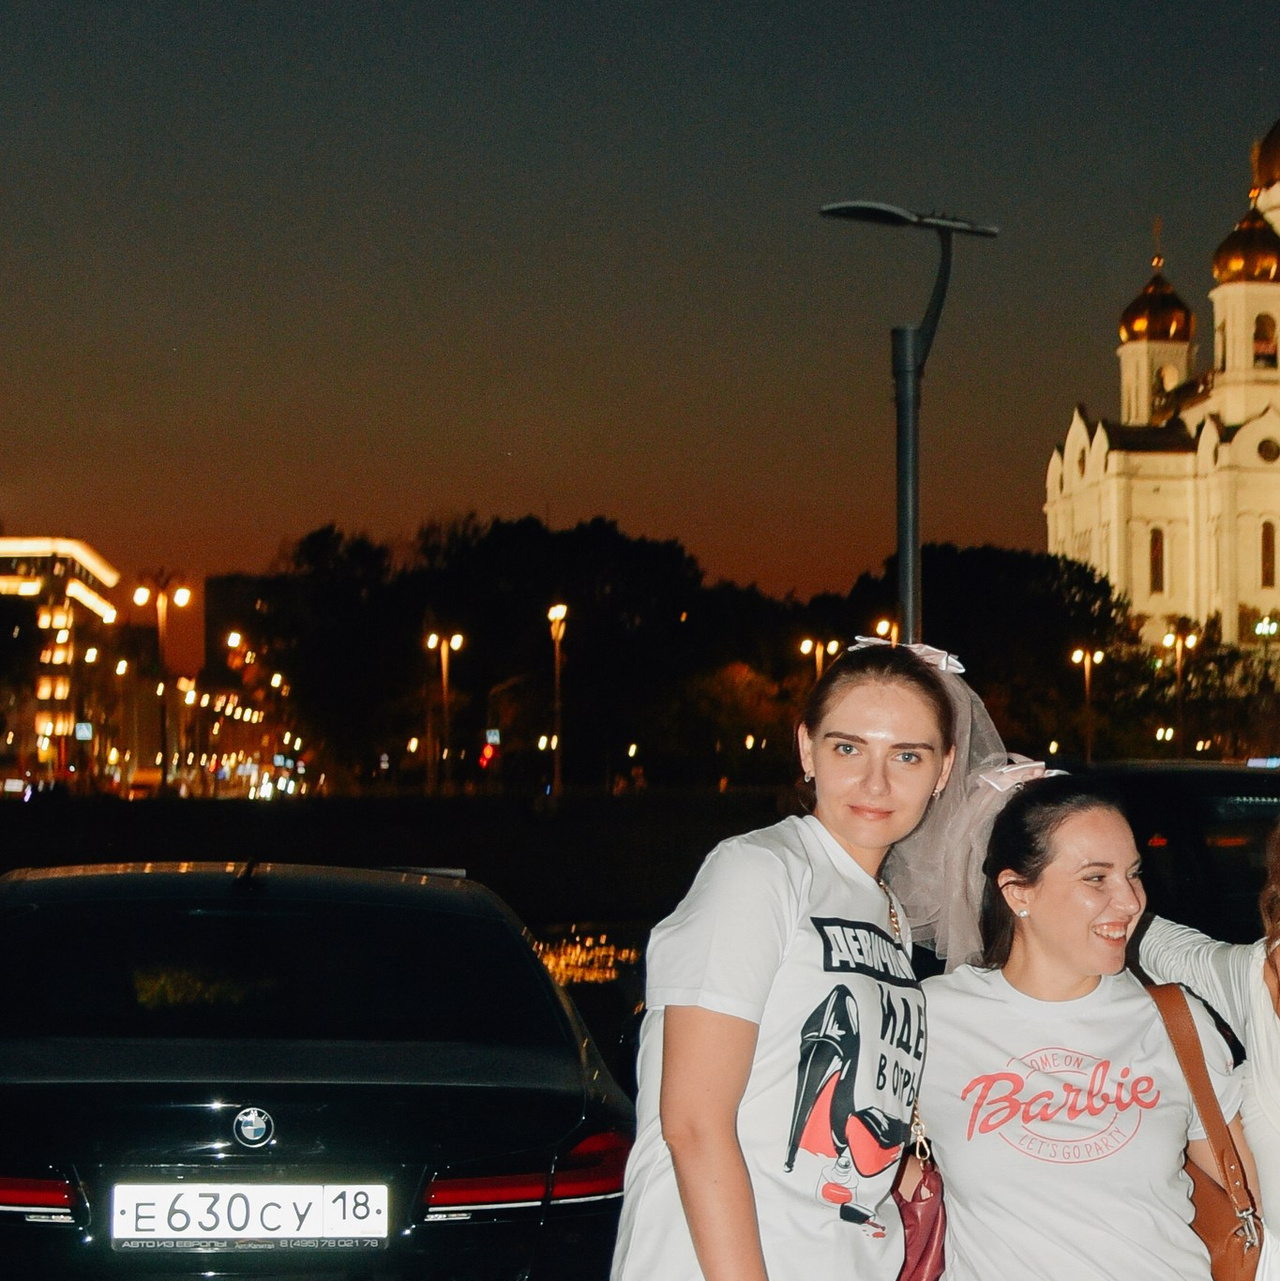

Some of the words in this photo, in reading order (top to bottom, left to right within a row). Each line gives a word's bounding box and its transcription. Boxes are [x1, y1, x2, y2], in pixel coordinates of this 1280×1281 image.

[876, 1052, 888, 1091] В
[1029, 1052, 1061, 1071] OME
[1064, 1054, 1084, 1069] ON
[960, 1059, 1161, 1142] Barbie
[1018, 1134, 1058, 1158] LET'S
[1062, 1145, 1081, 1160] GO
[1084, 1126, 1127, 1158] PARTY
[331, 1190, 371, 1221] 18
[121, 1240, 156, 1249] АВТО
[156, 1240, 175, 1249] ИЗ
[175, 1240, 228, 1249] ЕВРОПЫ
